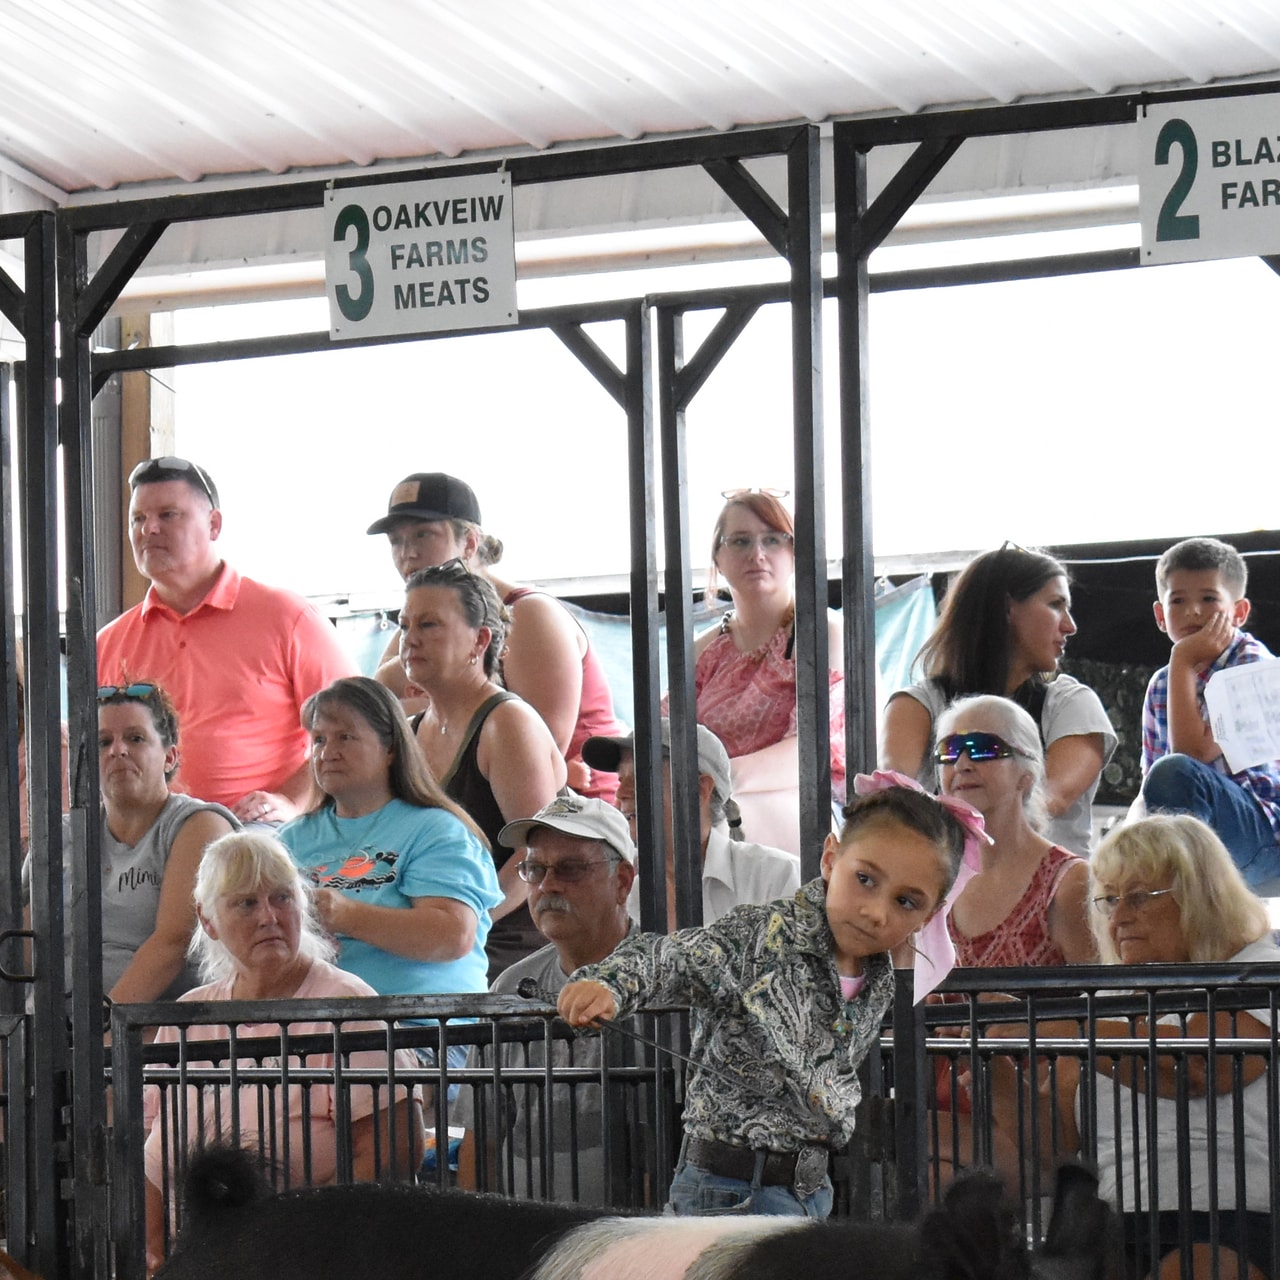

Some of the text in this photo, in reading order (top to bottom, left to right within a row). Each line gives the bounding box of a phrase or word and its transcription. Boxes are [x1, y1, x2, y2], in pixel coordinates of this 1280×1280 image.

[1155, 118, 1200, 242] 2
[372, 195, 504, 231] OAKVEIW
[333, 204, 375, 322] 3
[390, 236, 489, 270] FARMS
[393, 277, 490, 310] MEATS
